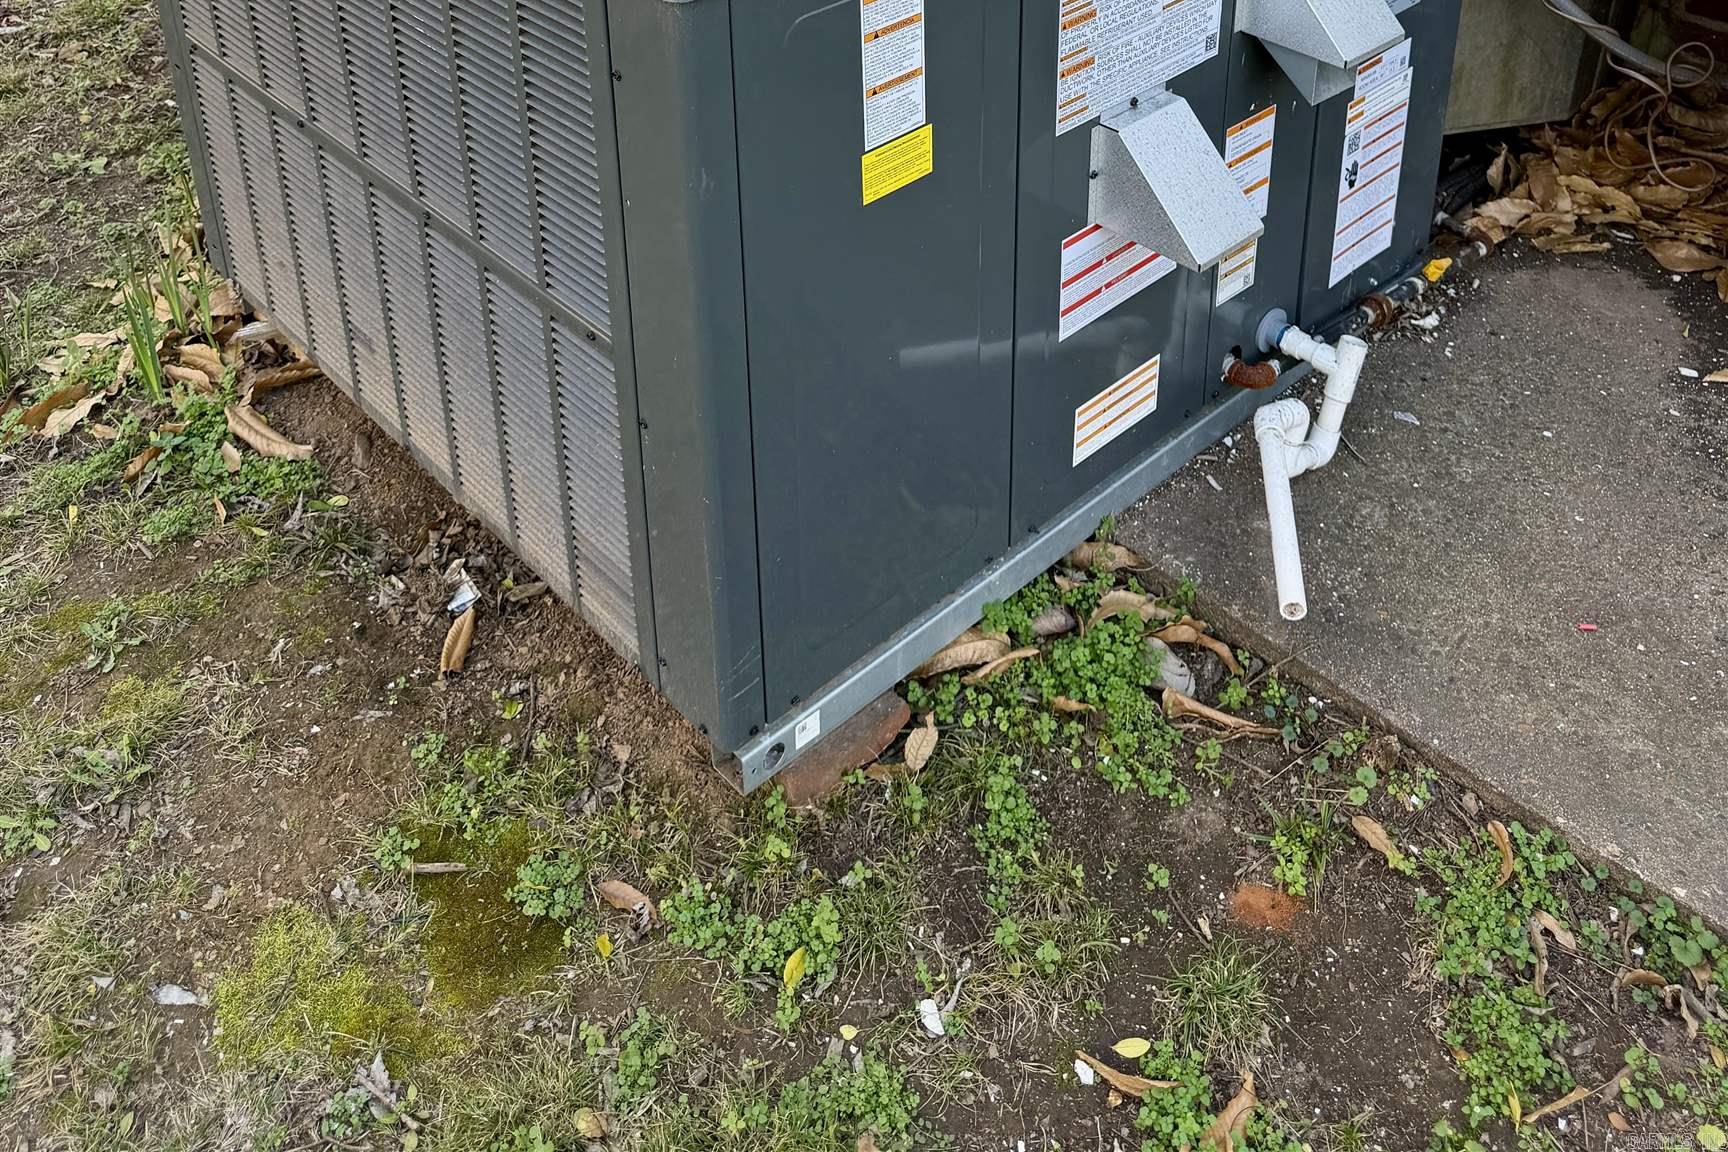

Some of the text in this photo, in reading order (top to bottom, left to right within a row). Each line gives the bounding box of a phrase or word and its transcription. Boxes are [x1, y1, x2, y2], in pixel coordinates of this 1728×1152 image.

[1068, 9, 1096, 29] WARNING
[1097, 16, 1135, 40] REFRIGERANT
[1100, 16, 1118, 31] LOCAL
[1097, 62, 1116, 78] OTHER
[1117, 54, 1133, 68] THAN
[1161, 30, 1184, 47] DEVICES
[1185, 21, 1202, 36] LISTED
[1067, 56, 1095, 77] WARNING
[1096, 51, 1123, 70] SOURCES
